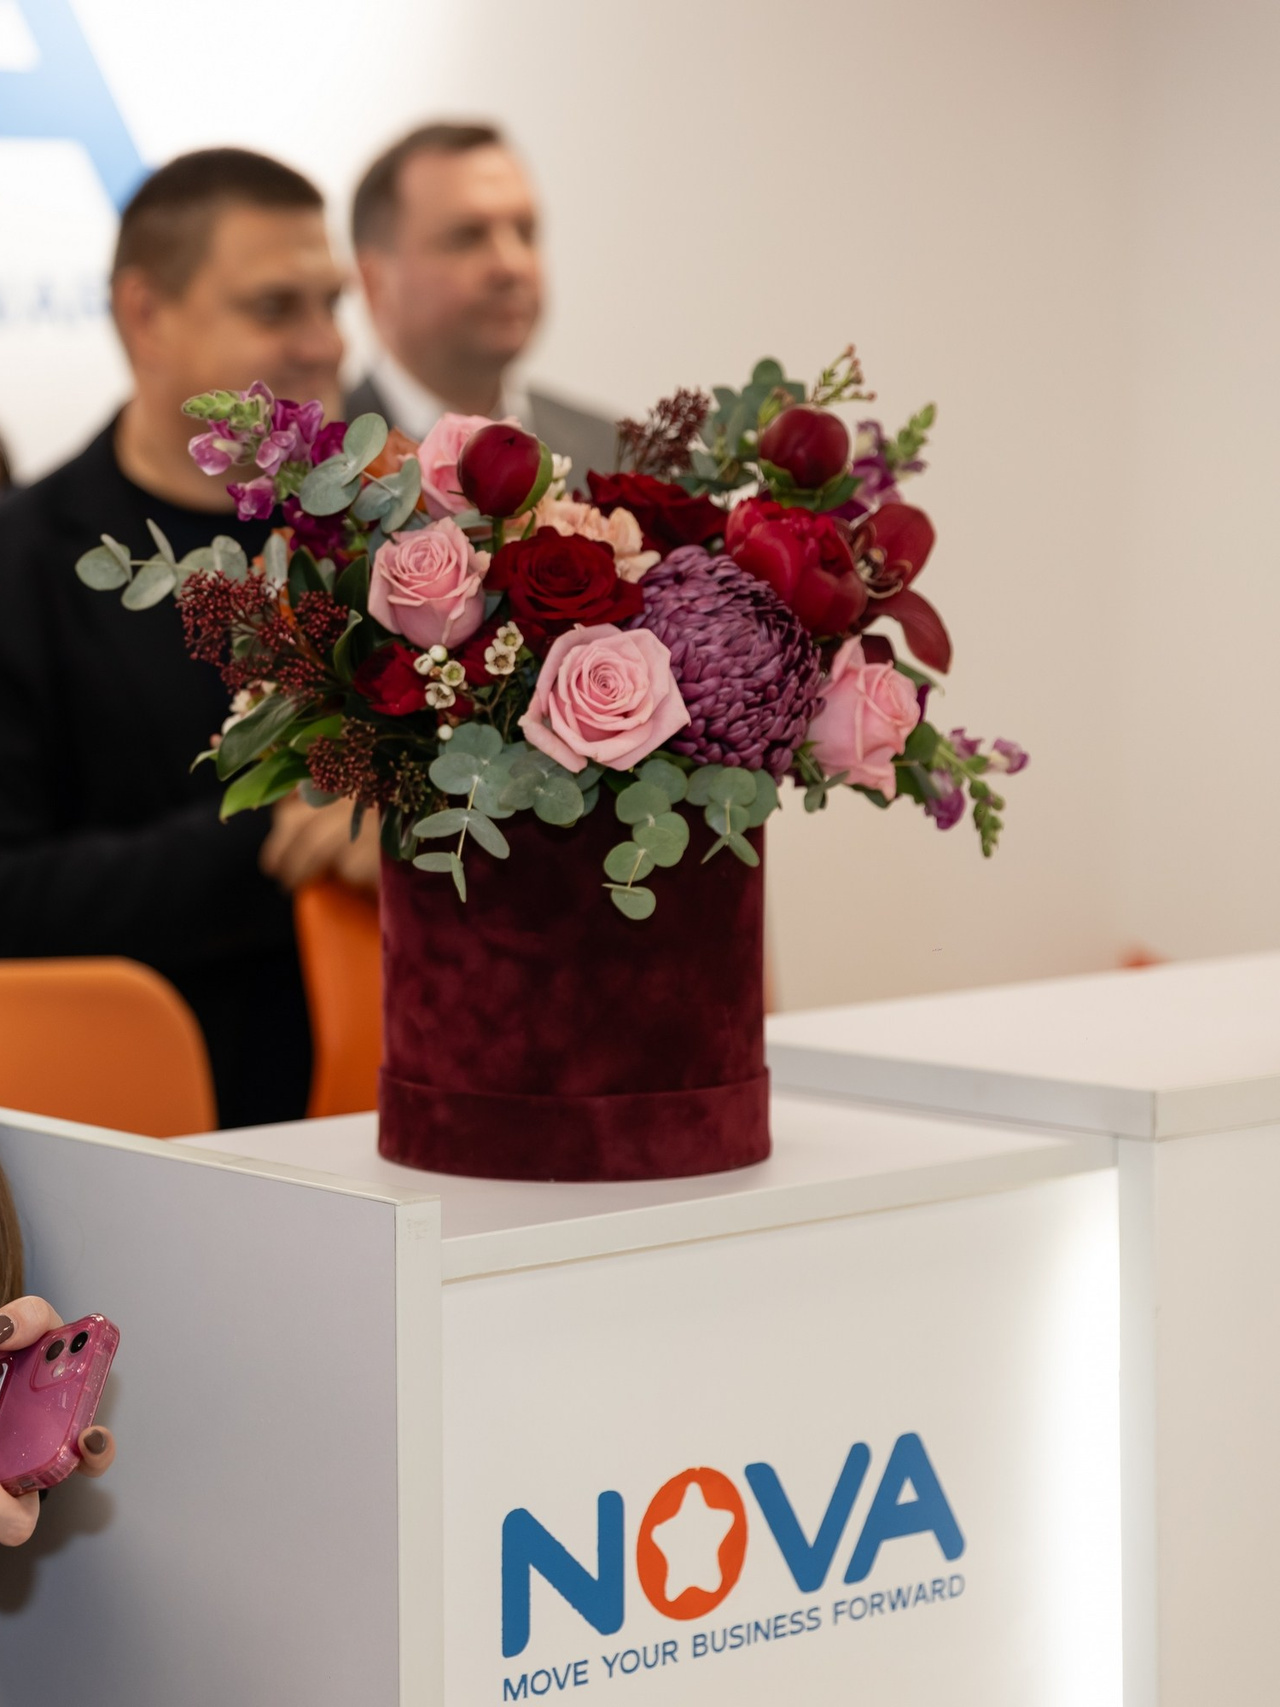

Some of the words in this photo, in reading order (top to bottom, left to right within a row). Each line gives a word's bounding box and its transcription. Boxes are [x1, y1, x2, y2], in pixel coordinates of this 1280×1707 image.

[501, 1432, 966, 1659] NOVA
[502, 1659, 590, 1702] MOVE
[601, 1639, 679, 1679] YOUR
[692, 1606, 822, 1658] BUSINESS
[832, 1573, 966, 1625] FORWARD
